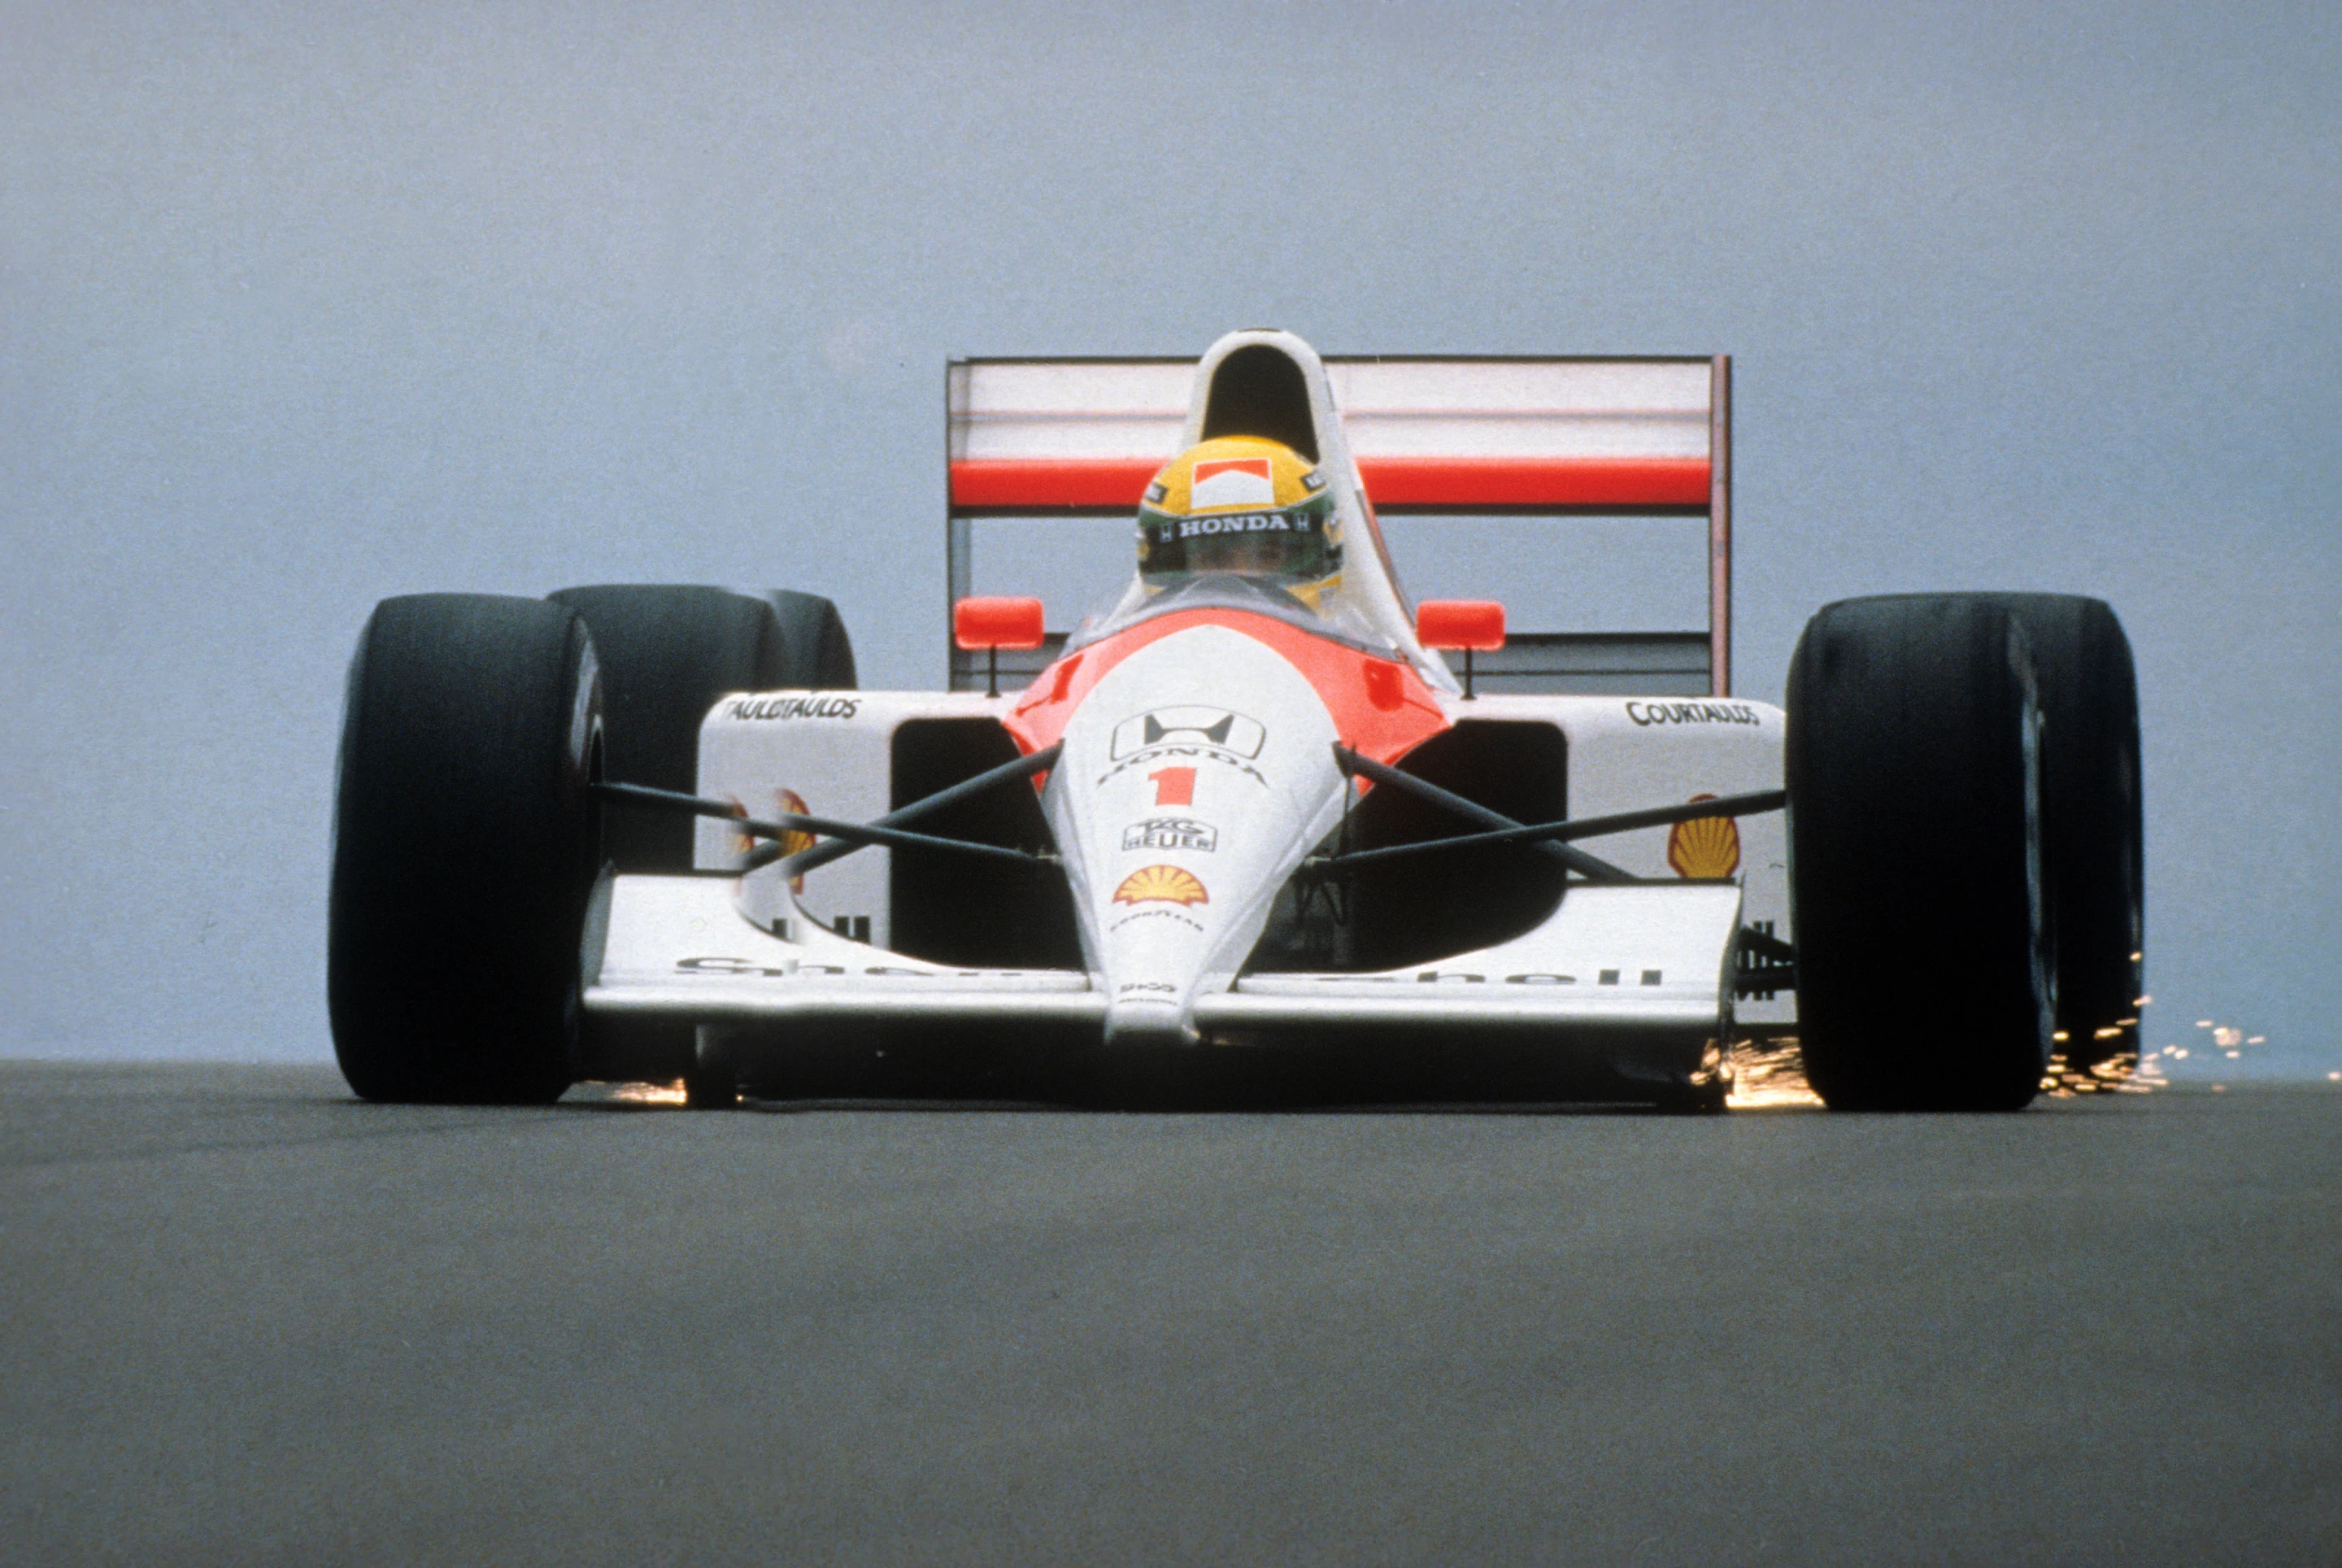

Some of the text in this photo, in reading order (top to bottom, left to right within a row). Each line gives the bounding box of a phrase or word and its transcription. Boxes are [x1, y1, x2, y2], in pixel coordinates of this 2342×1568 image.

[1180, 514, 1290, 538] HONDA
[1626, 701, 1761, 726] COURTAULDS
[1148, 767, 1197, 806] 1
